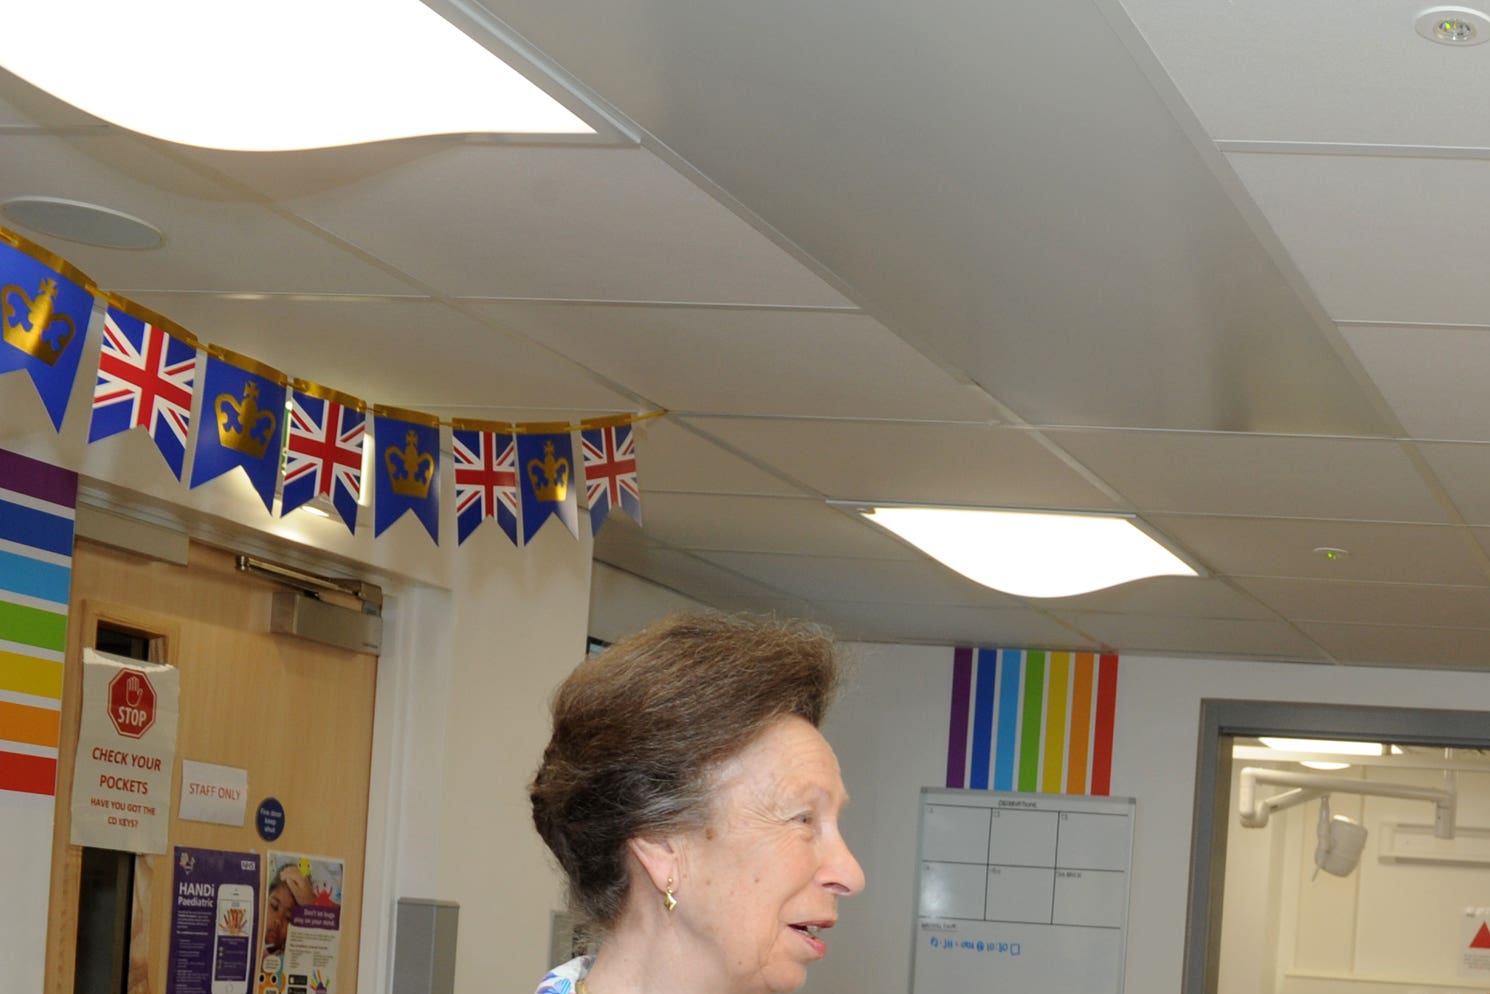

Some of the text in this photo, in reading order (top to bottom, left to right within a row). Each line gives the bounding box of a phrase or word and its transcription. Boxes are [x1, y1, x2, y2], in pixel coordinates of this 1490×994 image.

[117, 706, 147, 728] STOP
[92, 747, 162, 772] CHECK YOUR
[100, 774, 148, 795] POCKETS
[189, 782, 241, 801] STAFF ONLY
[90, 798, 156, 816] HAVE YOU GOT THE
[107, 816, 139, 828] CD KEYS?
[179, 882, 215, 897] HANDi
[177, 896, 214, 907] Paediatric
